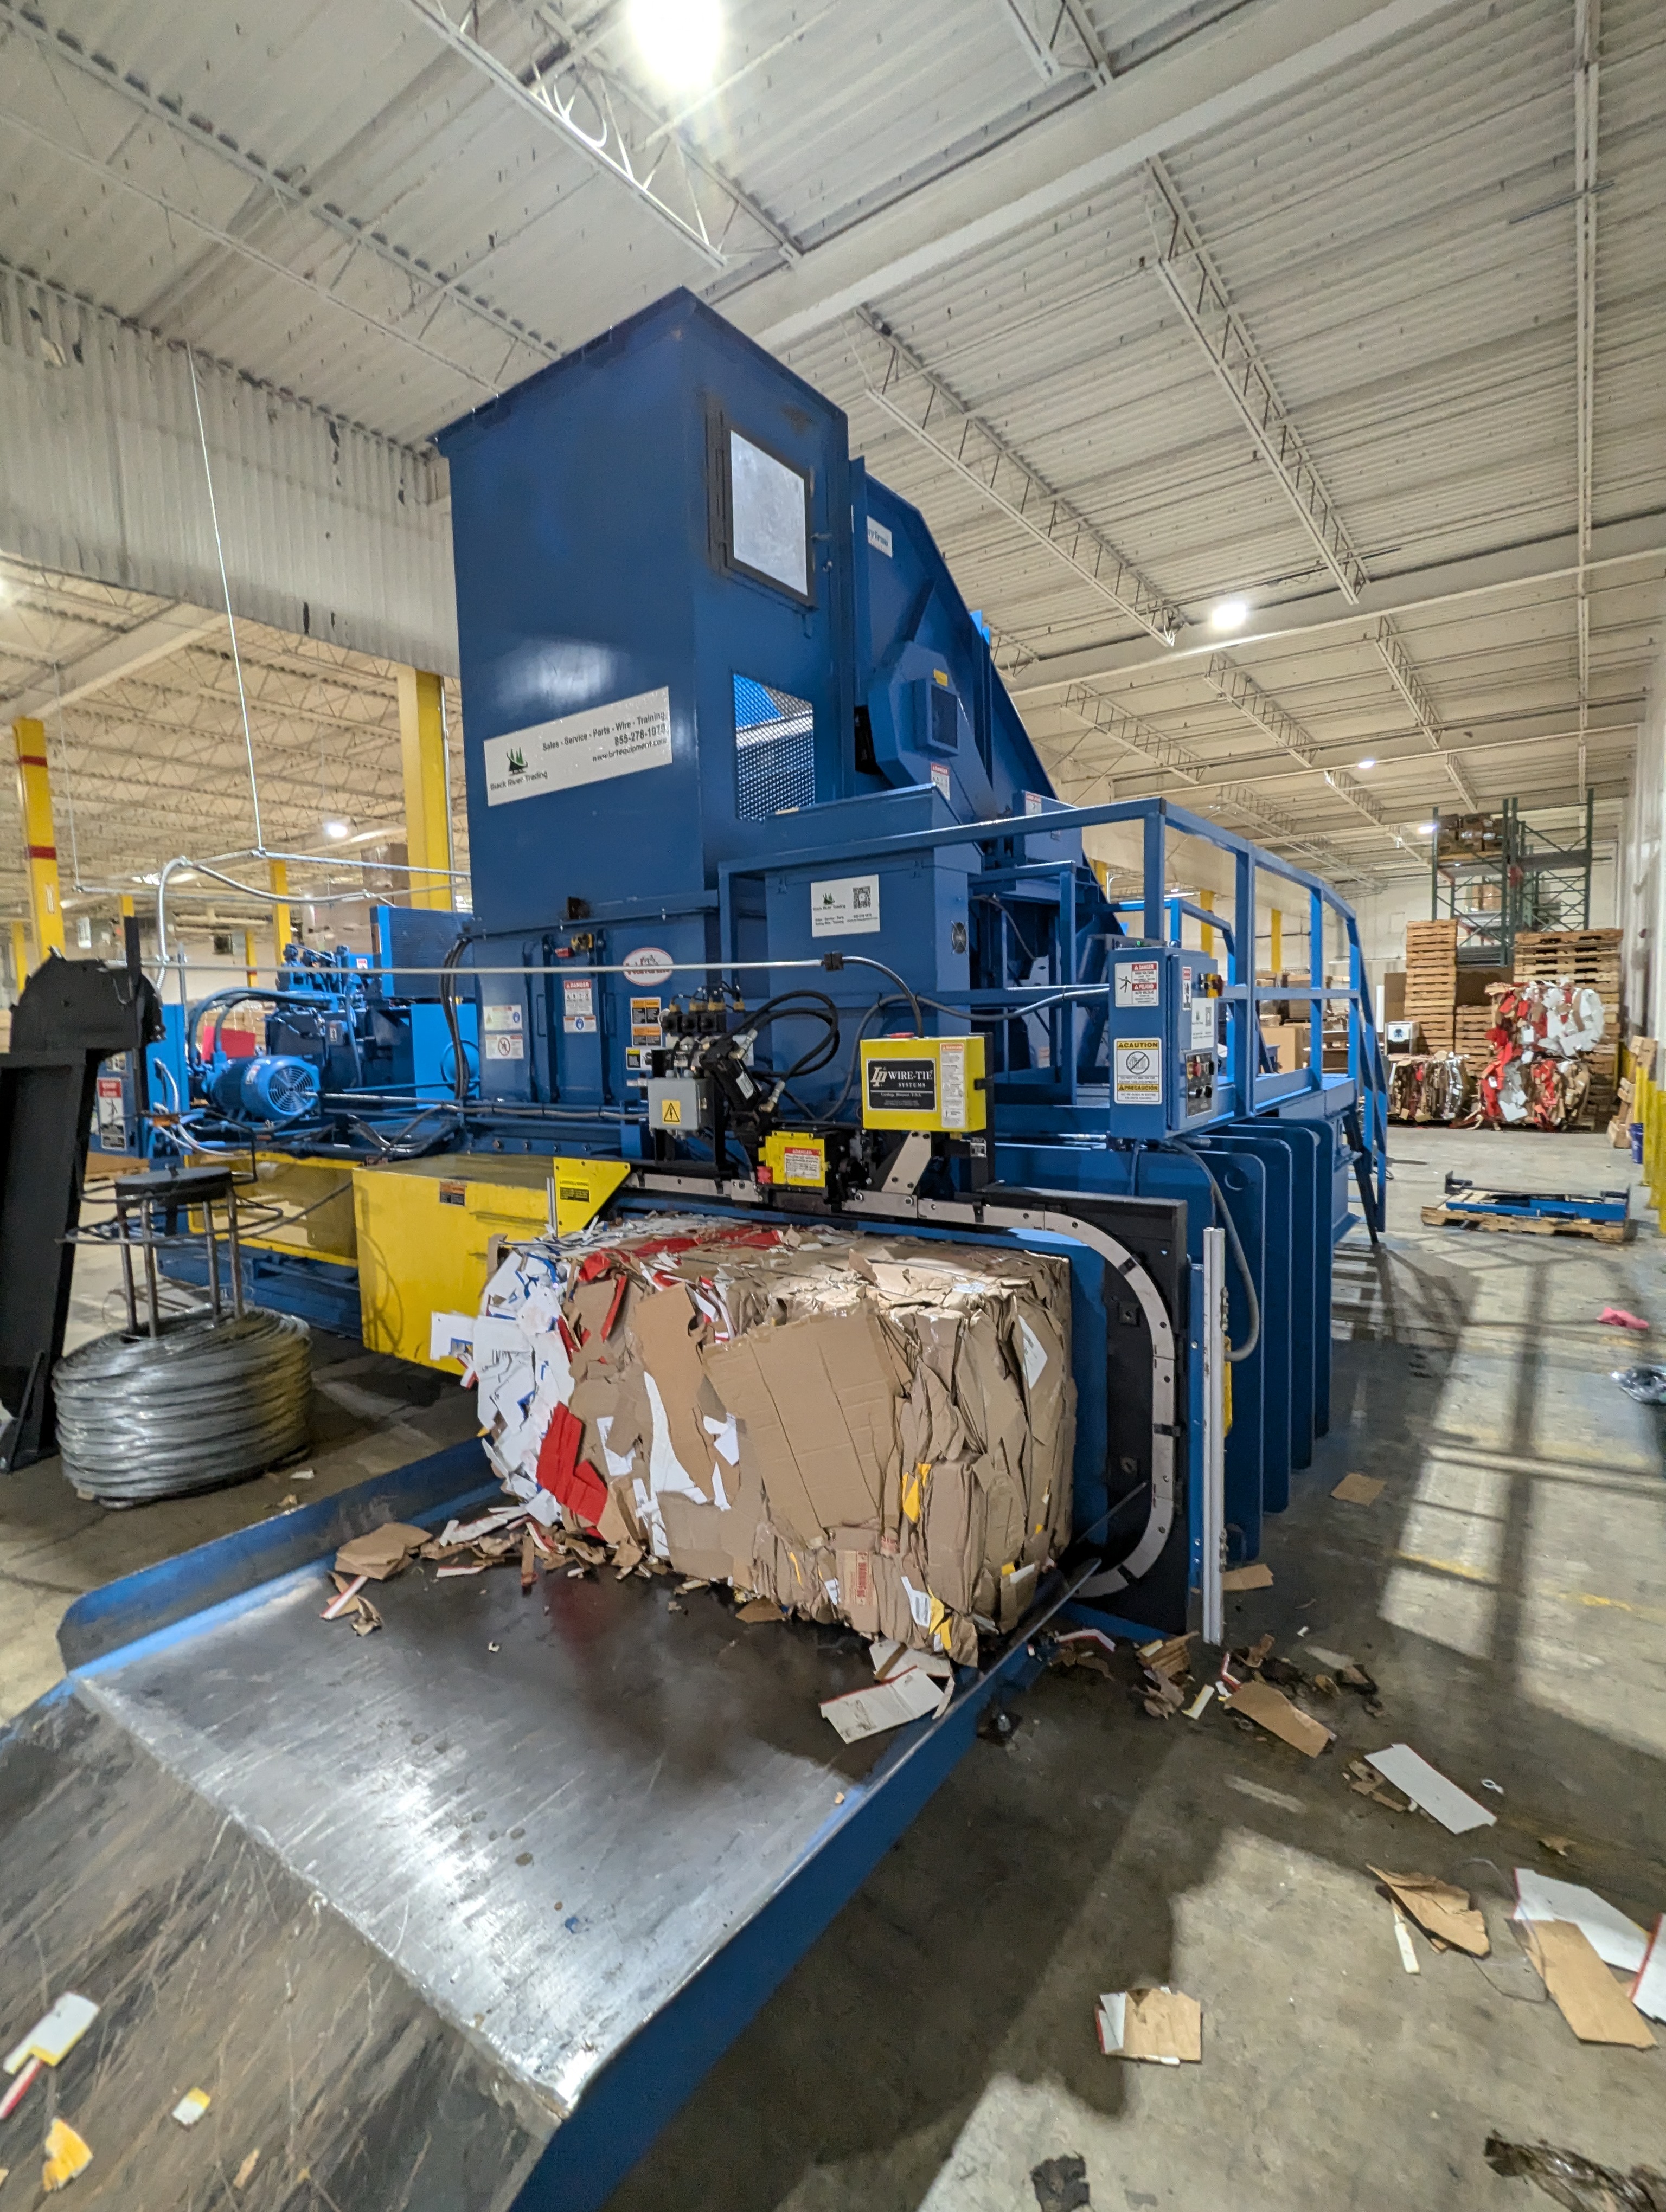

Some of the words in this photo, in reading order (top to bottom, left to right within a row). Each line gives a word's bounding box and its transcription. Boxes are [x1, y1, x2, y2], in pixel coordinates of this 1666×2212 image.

[542, 741, 559, 752] Sales
[564, 733, 588, 745] Service
[593, 727, 611, 738] Parts
[616, 720, 631, 731] Wire
[637, 712, 665, 725] Training
[888, 1071, 933, 1080] WIRE-TIE
